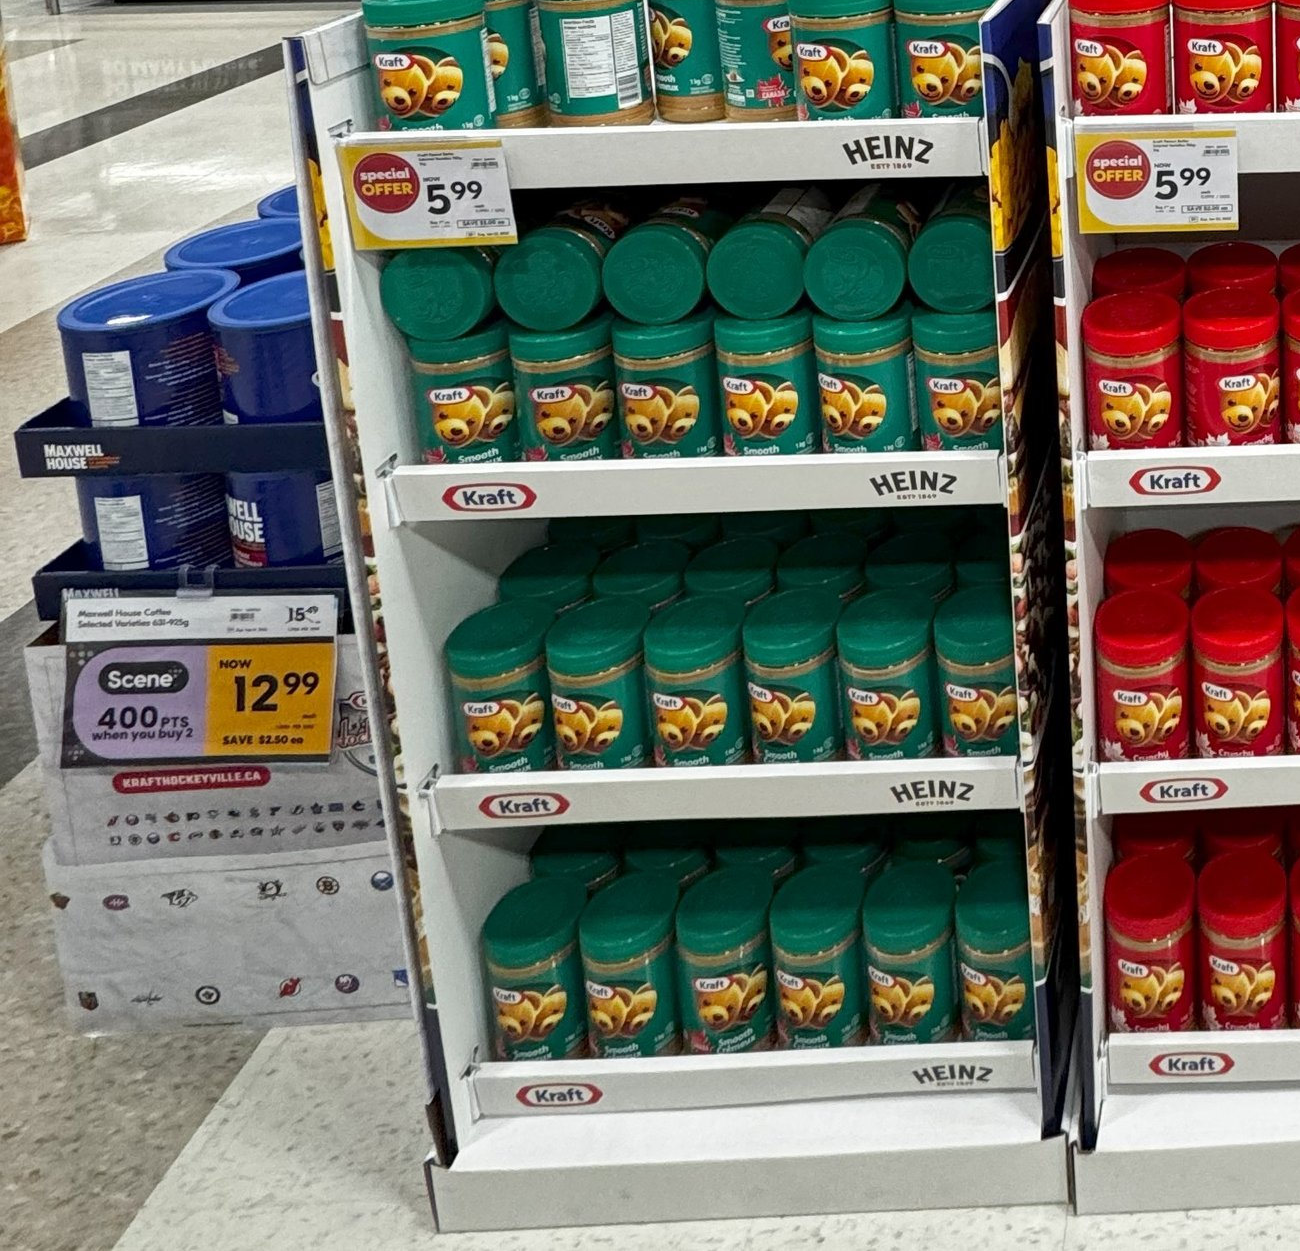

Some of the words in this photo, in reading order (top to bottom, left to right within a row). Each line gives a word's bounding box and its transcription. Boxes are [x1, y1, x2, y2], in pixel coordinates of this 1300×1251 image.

[378, 54, 406, 69] Kraft
[1093, 156, 1142, 169] special
[360, 167, 410, 182] special
[1093, 170, 1143, 182] OFFER
[362, 182, 413, 196] OFFER
[44, 445, 104, 458] MAXWELL
[46, 457, 88, 470] HOUSE
[462, 487, 517, 507] Kraft
[226, 497, 263, 522] WELL
[230, 522, 265, 543] OUSE
[77, 609, 113, 618] Maxwell
[115, 609, 142, 618] House
[144, 608, 172, 617] Coffee
[77, 620, 113, 629] Selected
[115, 619, 151, 628] Varieties
[219, 659, 252, 669] NOW
[96, 707, 158, 729] 400
[160, 716, 189, 728] PTS
[91, 730, 128, 741] when
[132, 731, 156, 742] you
[158, 728, 184, 741] buy
[185, 728, 193, 738] 2
[223, 735, 253, 745] SAVE
[259, 735, 288, 745] $2.50
[123, 771, 262, 789] KRAFTHOCKEYVILLE.CA
[890, 780, 975, 804] HEINZ
